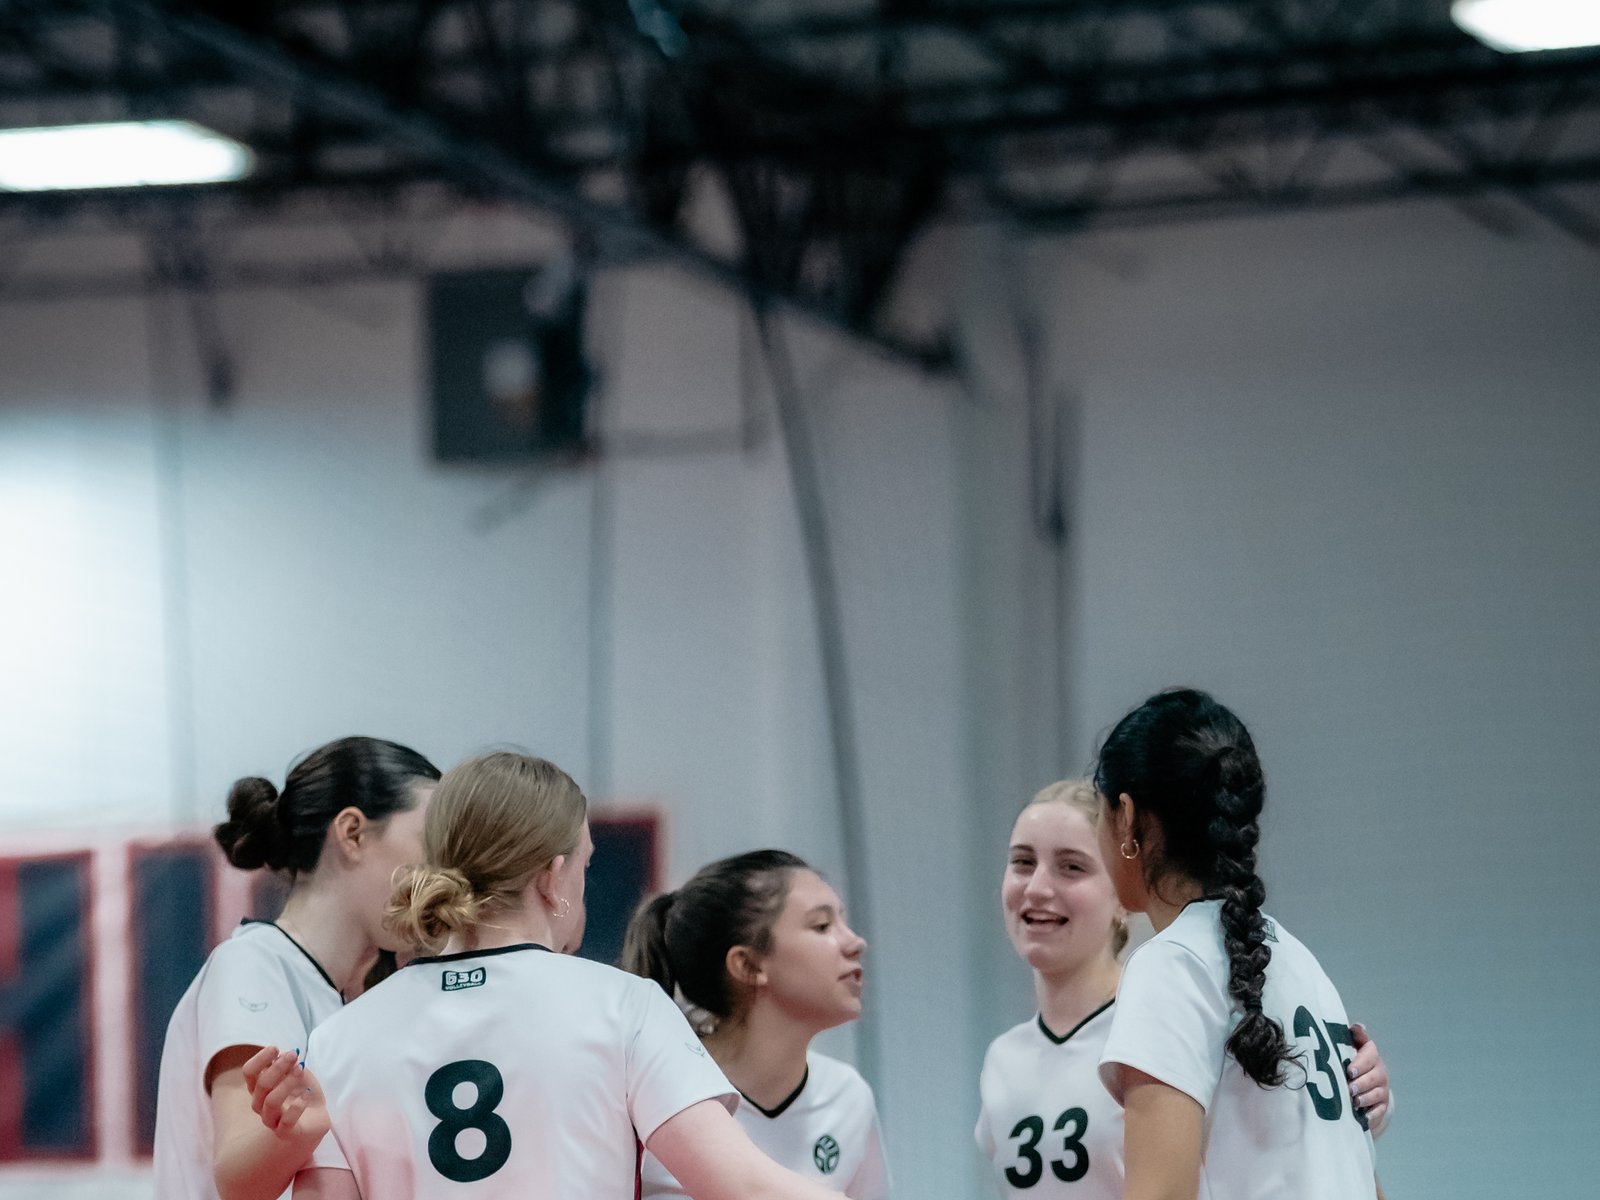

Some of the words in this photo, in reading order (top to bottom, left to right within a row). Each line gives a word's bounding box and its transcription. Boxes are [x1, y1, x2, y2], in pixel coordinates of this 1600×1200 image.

[445, 970, 483, 985] 630
[424, 1059, 512, 1183] 8
[1004, 1107, 1090, 1190] 33
